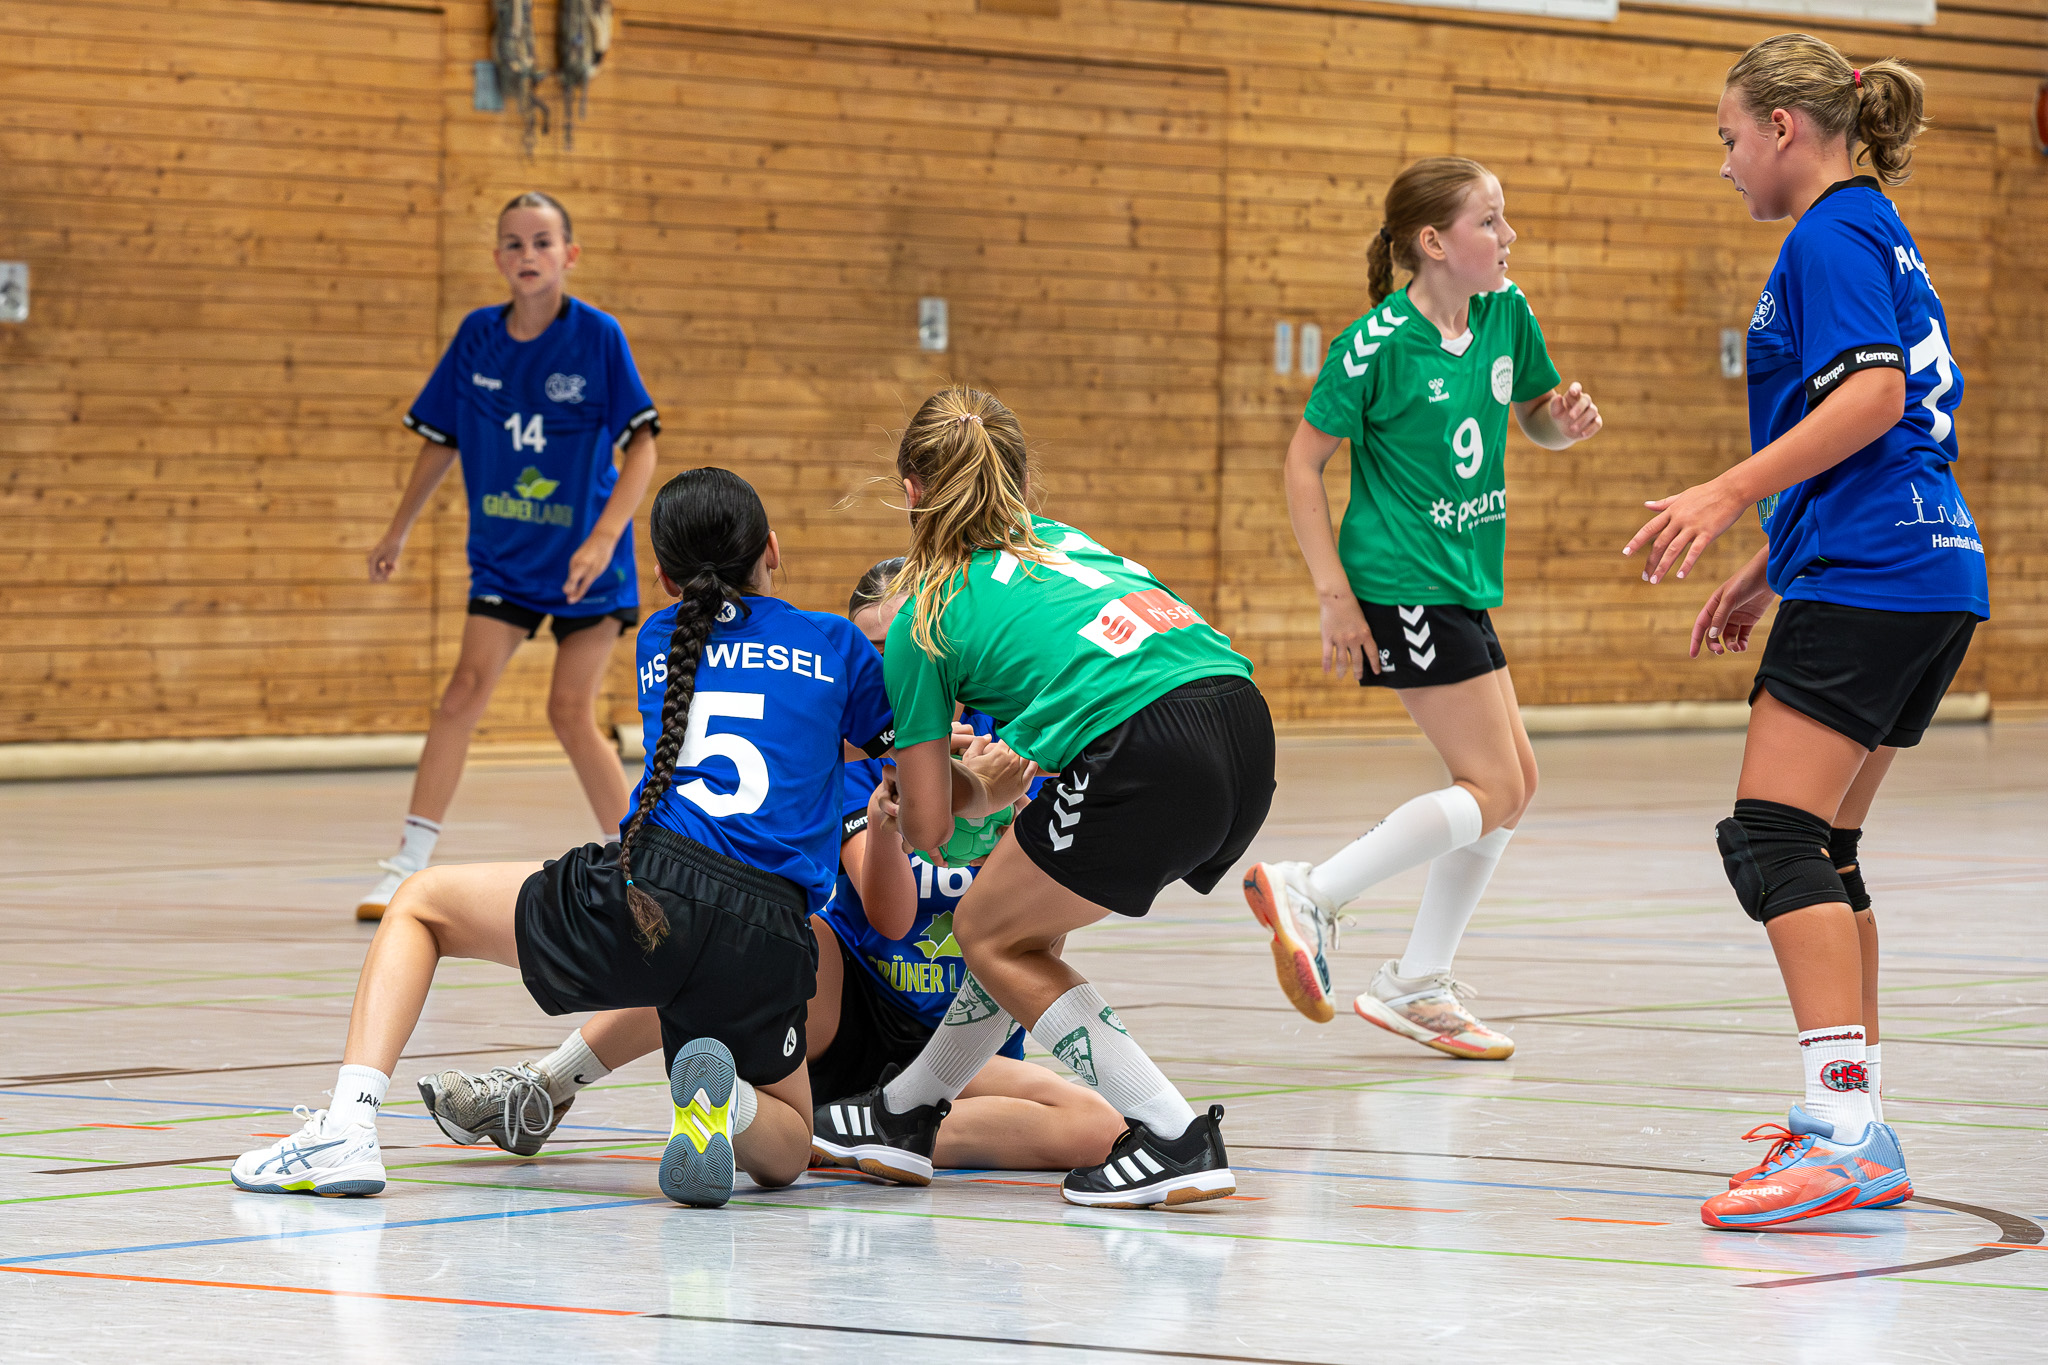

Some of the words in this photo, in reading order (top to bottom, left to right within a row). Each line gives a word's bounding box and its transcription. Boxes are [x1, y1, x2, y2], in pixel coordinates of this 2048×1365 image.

[1855, 350, 1899, 364] Kempa
[1813, 362, 1845, 389] Kempa
[504, 412, 547, 453] 14
[1452, 417, 1484, 479] 9
[639, 652, 668, 694] HS
[705, 642, 834, 683] WESEL
[676, 691, 769, 818] 5
[868, 955, 944, 994] RÜNER
[356, 1091, 381, 1112] JAK
[1836, 1080, 1869, 1090] WESE
[1728, 1185, 1783, 1198] Kempa
